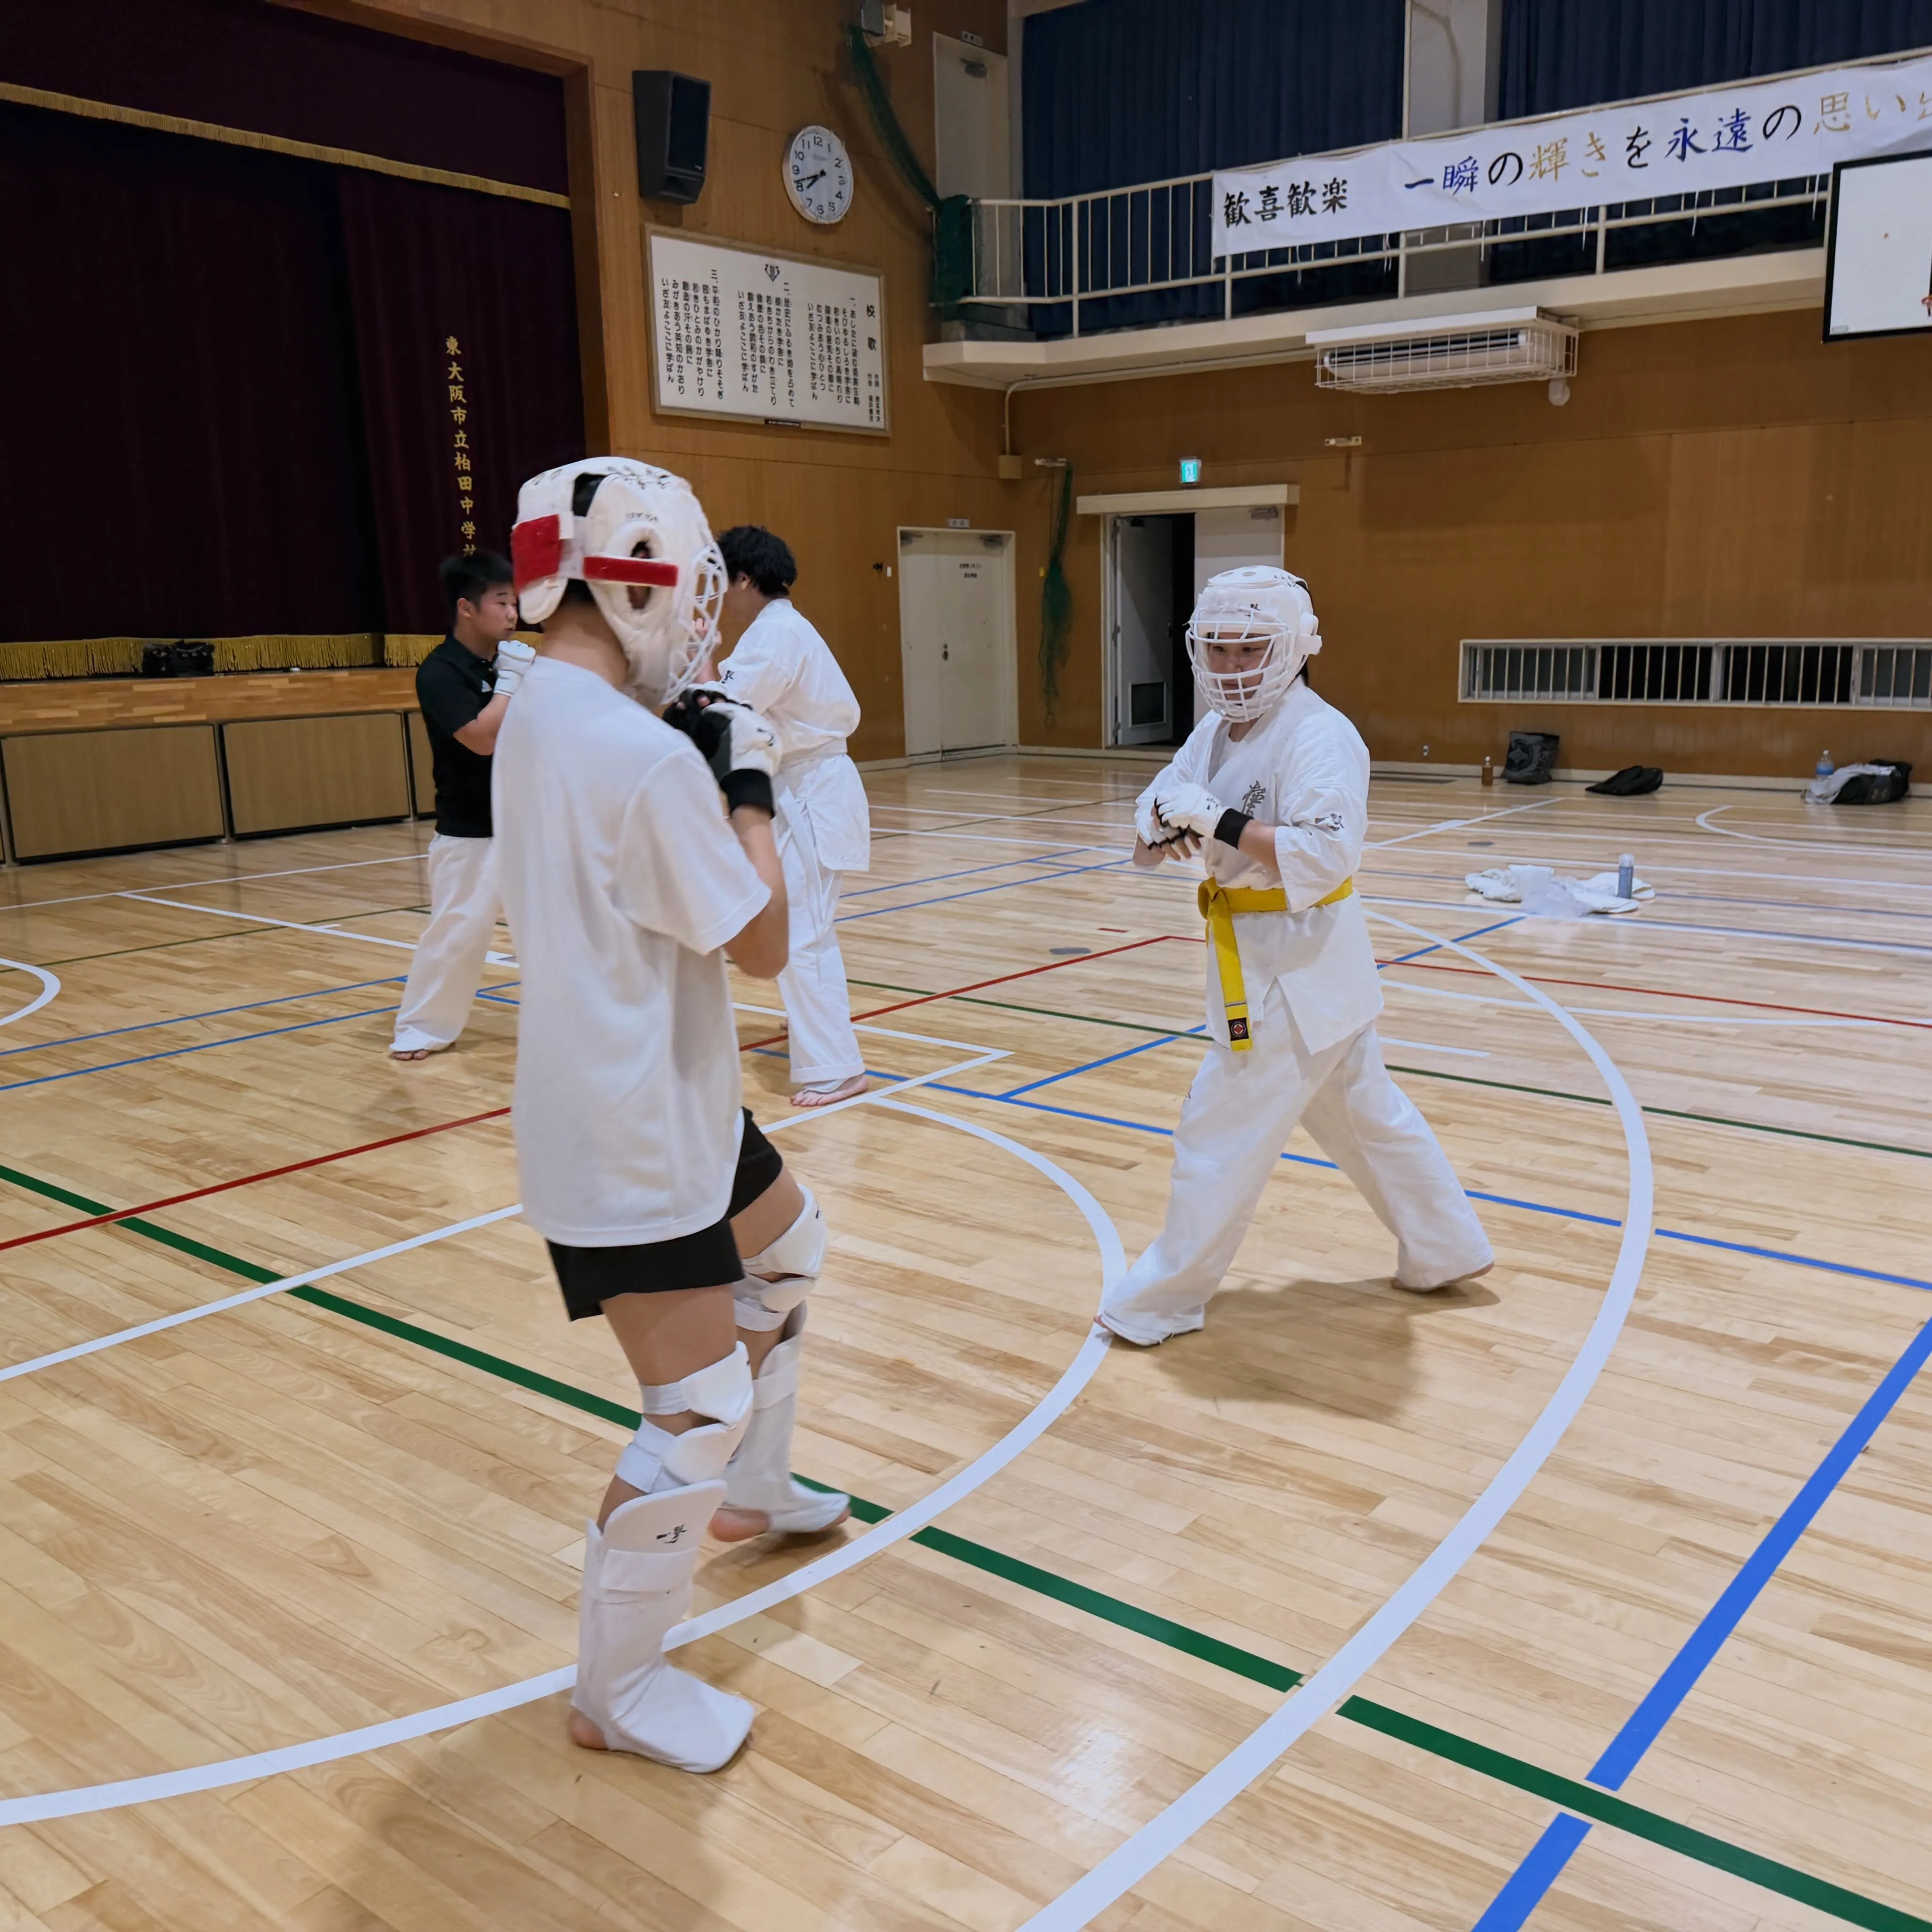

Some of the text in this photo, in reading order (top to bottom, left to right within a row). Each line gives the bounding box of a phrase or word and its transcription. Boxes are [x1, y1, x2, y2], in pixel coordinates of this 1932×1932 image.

[802, 139, 810, 150] 11
[814, 136, 822, 147] 12
[828, 143, 831, 152] 1
[795, 150, 804, 160] 10
[834, 158, 841, 167] 2
[792, 166, 800, 175] 9
[839, 176, 845, 185] 3
[796, 182, 804, 192] 8
[835, 191, 842, 200] 4
[806, 198, 812, 207] 7
[828, 202, 835, 211] 5
[1224, 177, 1348, 228] 歓喜歓楽
[817, 205, 824, 214] 6
